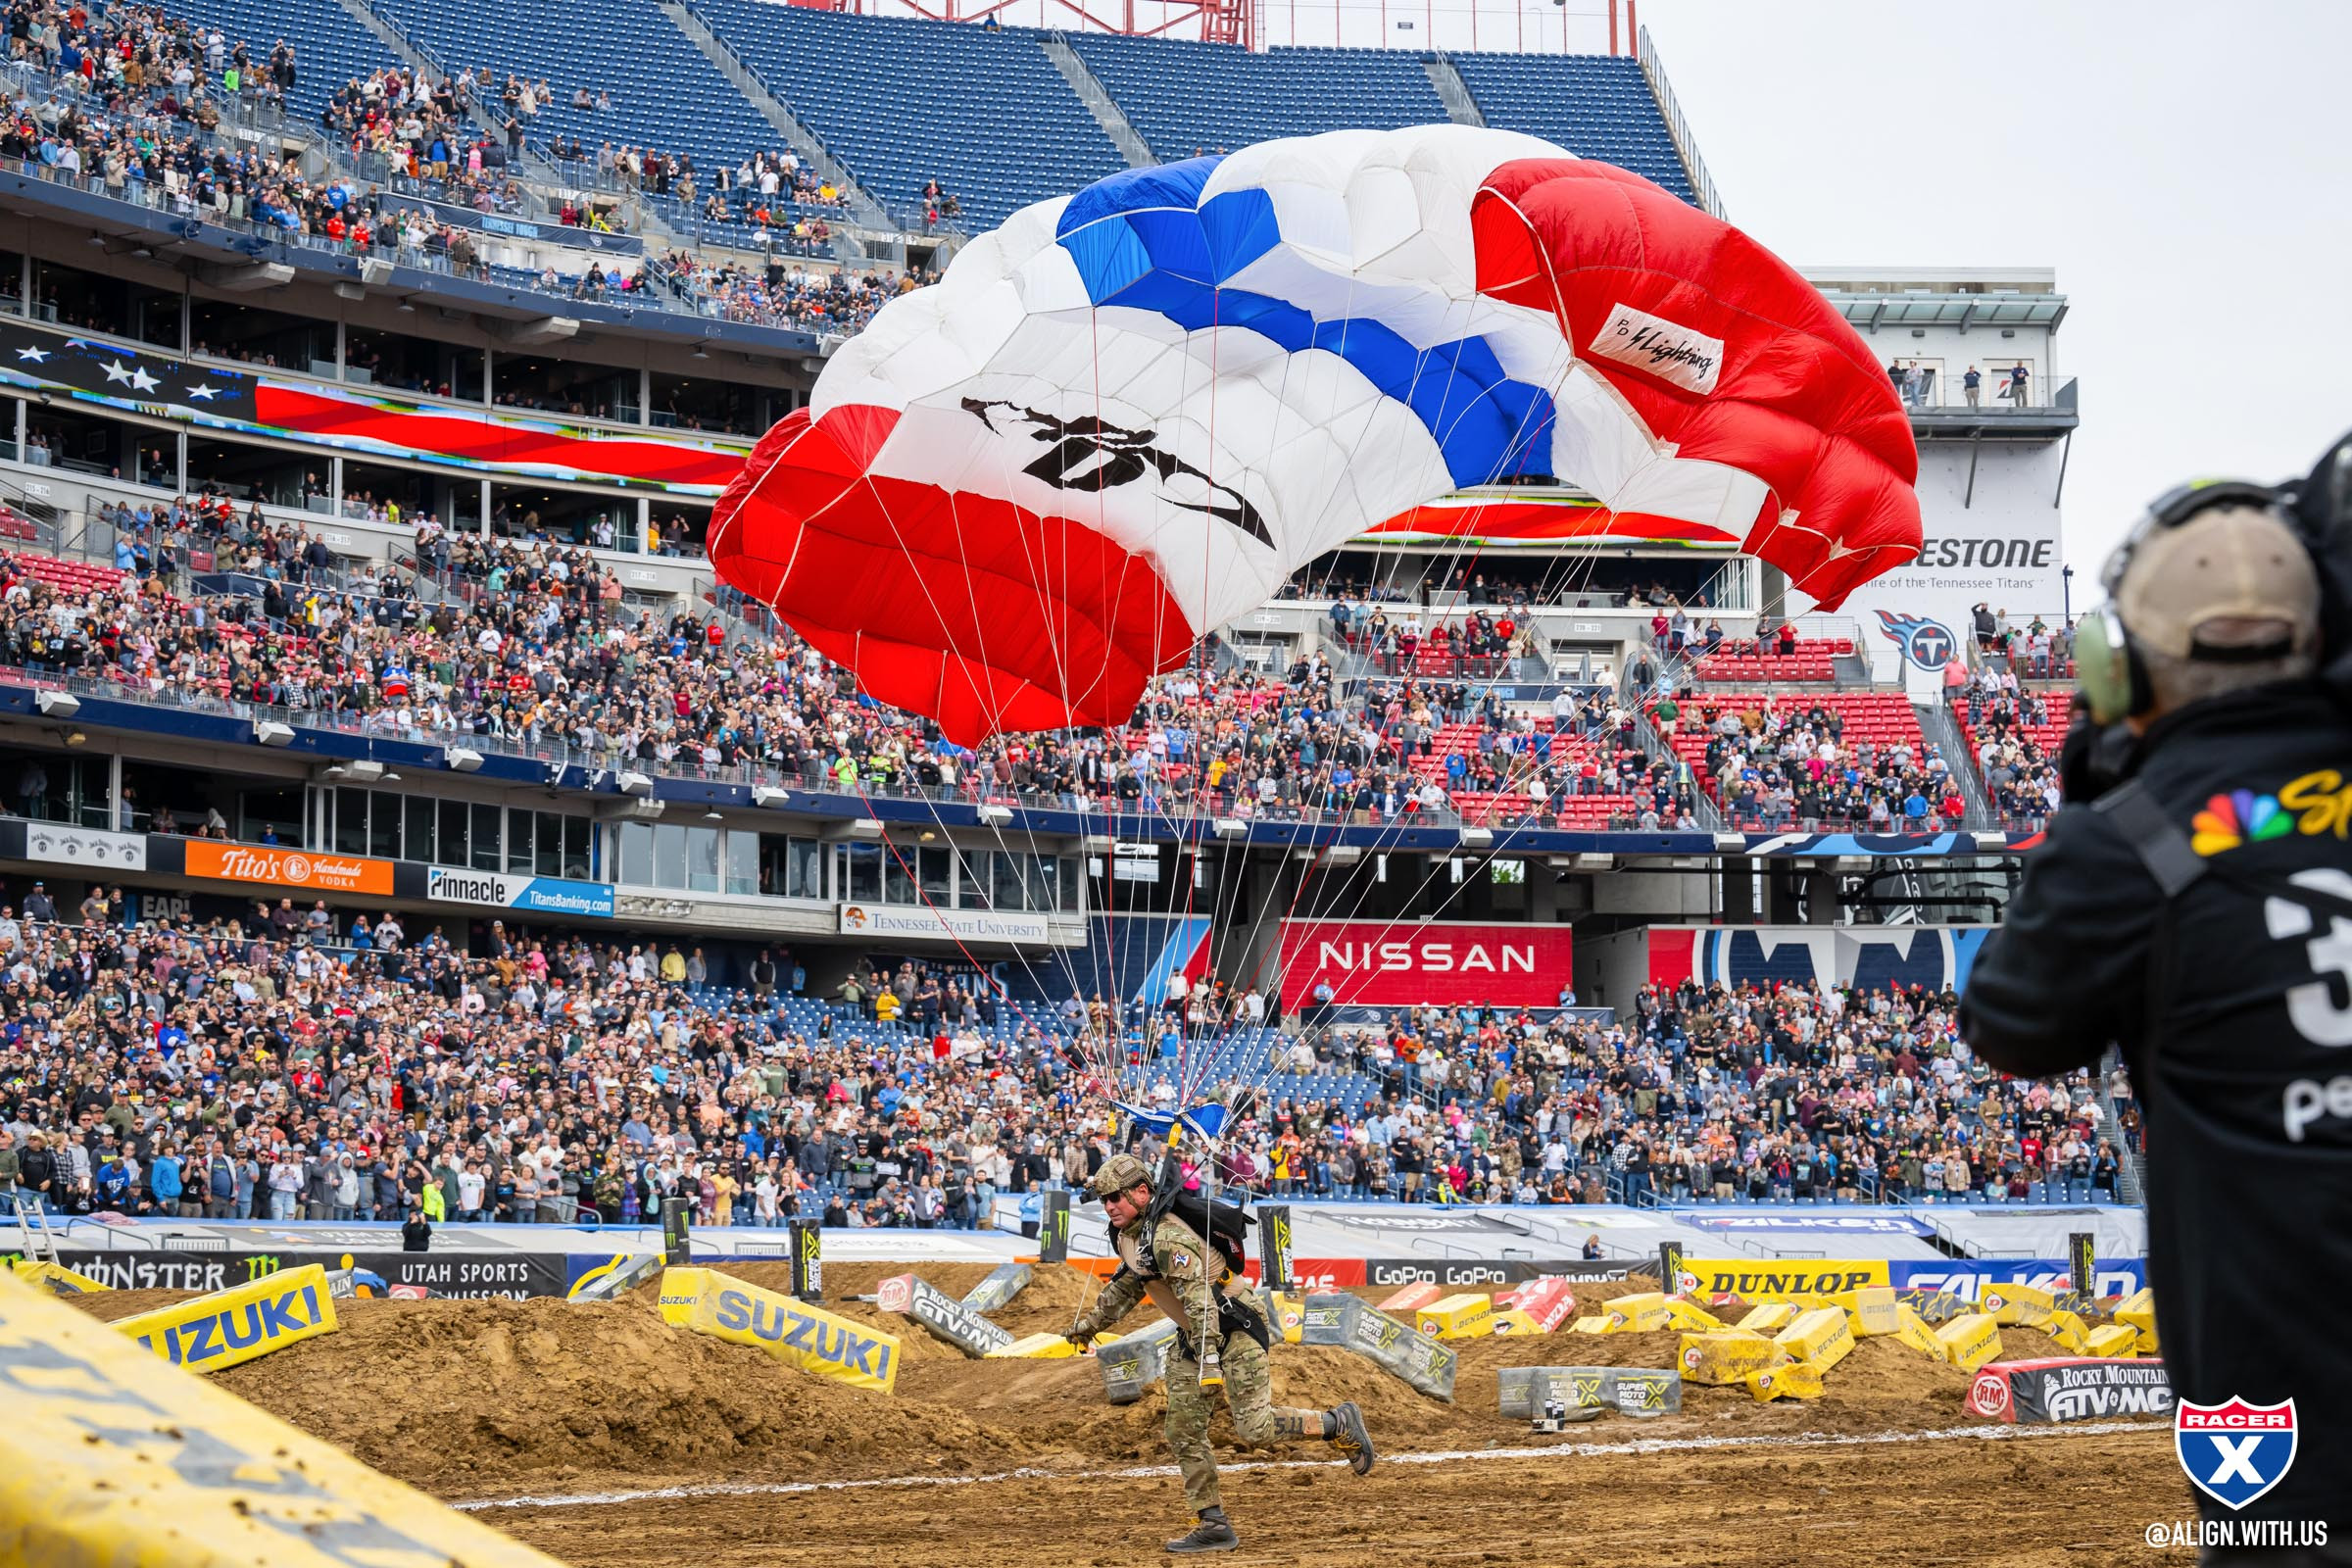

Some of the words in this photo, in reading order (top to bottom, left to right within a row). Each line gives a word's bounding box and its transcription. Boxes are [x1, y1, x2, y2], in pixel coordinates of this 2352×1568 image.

[1898, 538, 2054, 567] ESTONE
[1890, 577, 1903, 588] of
[1906, 577, 1926, 588] the
[1931, 578, 1992, 588] Tennessee
[1997, 578, 2034, 588] Titans
[221, 849, 280, 880] Tito's
[313, 858, 362, 877] Handmade
[319, 876, 356, 887] VODKA
[431, 869, 506, 903] Pinnacle
[530, 890, 612, 912] TitansBanking.com
[871, 913, 938, 931] TENNESSEE
[940, 917, 974, 934] STATE
[977, 920, 1045, 938] UNIVERSITY
[1319, 942, 1535, 972] NISSAN
[402, 1263, 452, 1283] UTAH
[461, 1262, 528, 1283] SPORTS
[1375, 1266, 1436, 1286] GoPro
[1446, 1267, 1505, 1286] GoPro
[1710, 1272, 1870, 1294] DUNLOP
[929, 1289, 960, 1316] ROCKY
[1360, 1311, 1384, 1328] SUPER
[1360, 1322, 1383, 1337] MOTO
[716, 1290, 891, 1380] SUZUKI
[1817, 1324, 1848, 1356] DUNLOP
[1966, 1330, 1998, 1358] DUNLOP
[1549, 1381, 1578, 1391] SUPER
[2061, 1368, 2102, 1389] ROCKY
[2105, 1365, 2170, 1386] MOUNTAIN
[1551, 1389, 1578, 1398] MOTO
[1620, 1398, 1646, 1407] CROSS
[1978, 1387, 2005, 1408] RM
